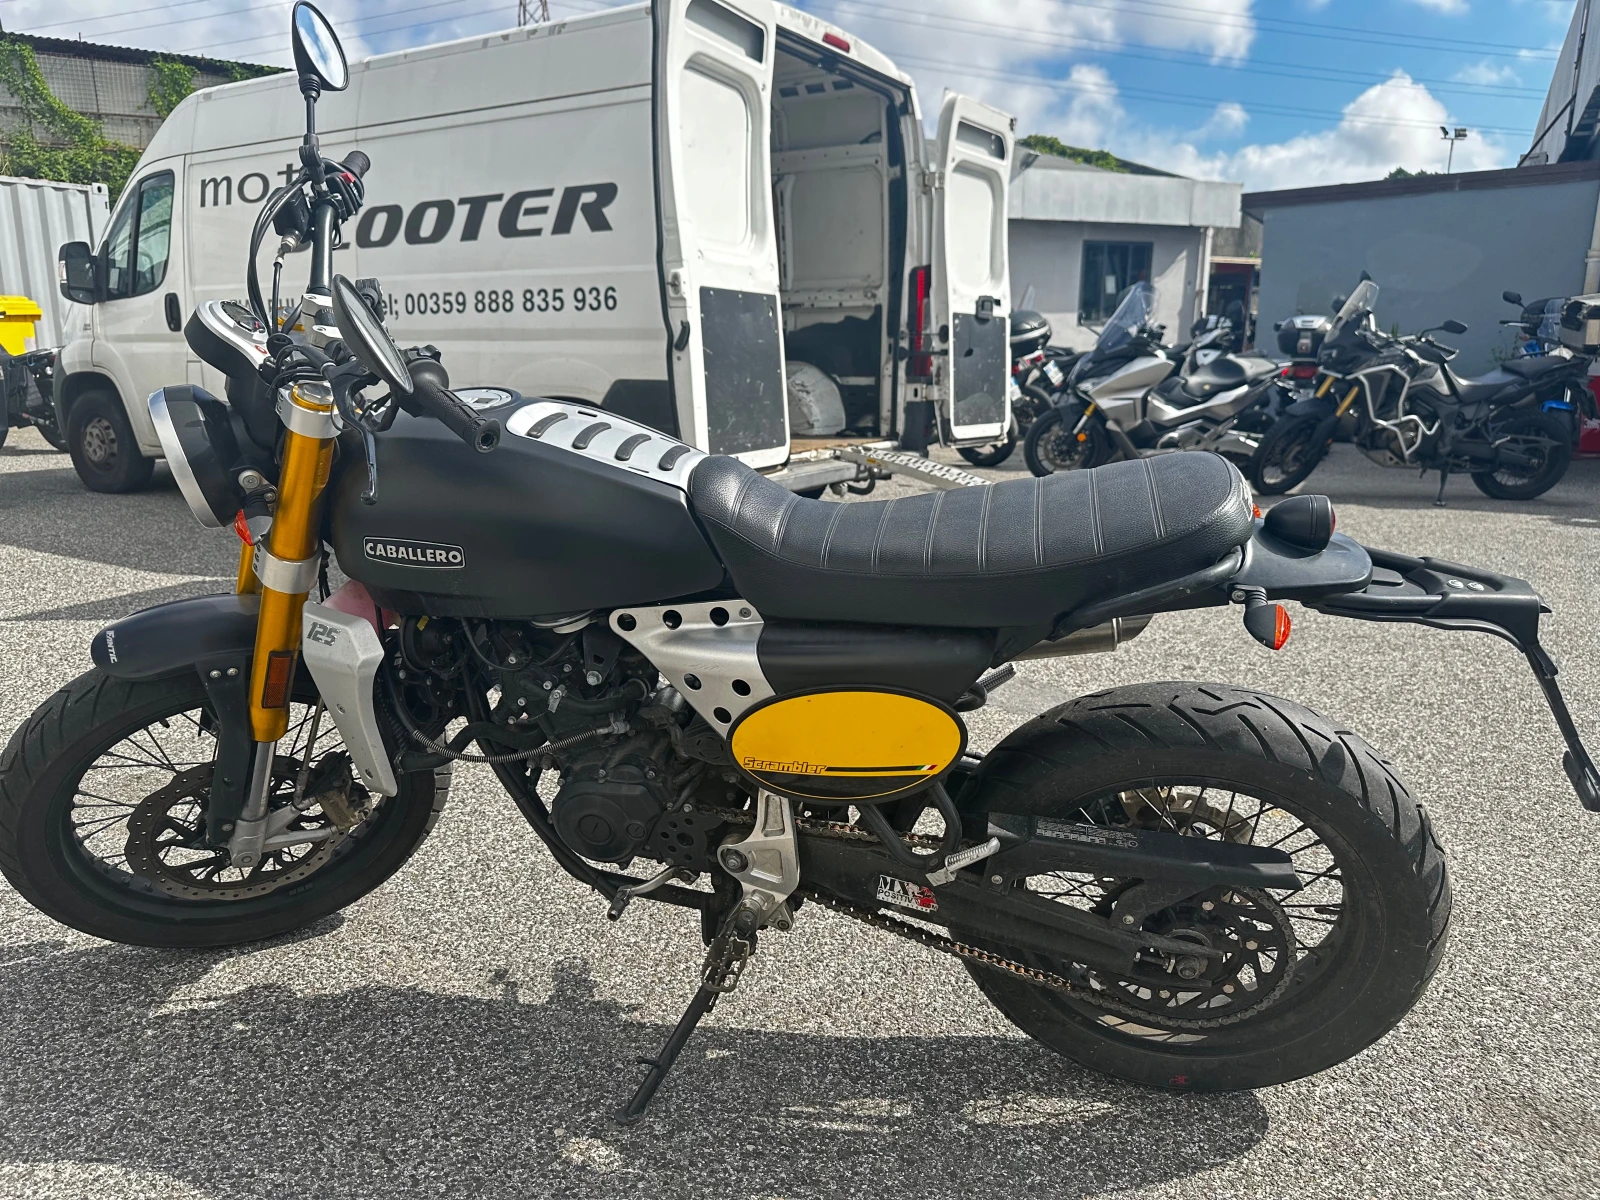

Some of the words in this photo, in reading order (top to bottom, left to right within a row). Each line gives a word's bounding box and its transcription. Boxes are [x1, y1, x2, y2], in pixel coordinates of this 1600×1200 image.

[200, 163, 300, 207] mot
[285, 182, 618, 254] OOTER
[405, 292, 466, 315] 00359
[474, 289, 514, 313] 888
[522, 288, 565, 312] 835
[573, 286, 617, 311] 936
[365, 542, 462, 563] CABALLERO
[307, 621, 341, 646] 125
[743, 757, 826, 774] Scrambler
